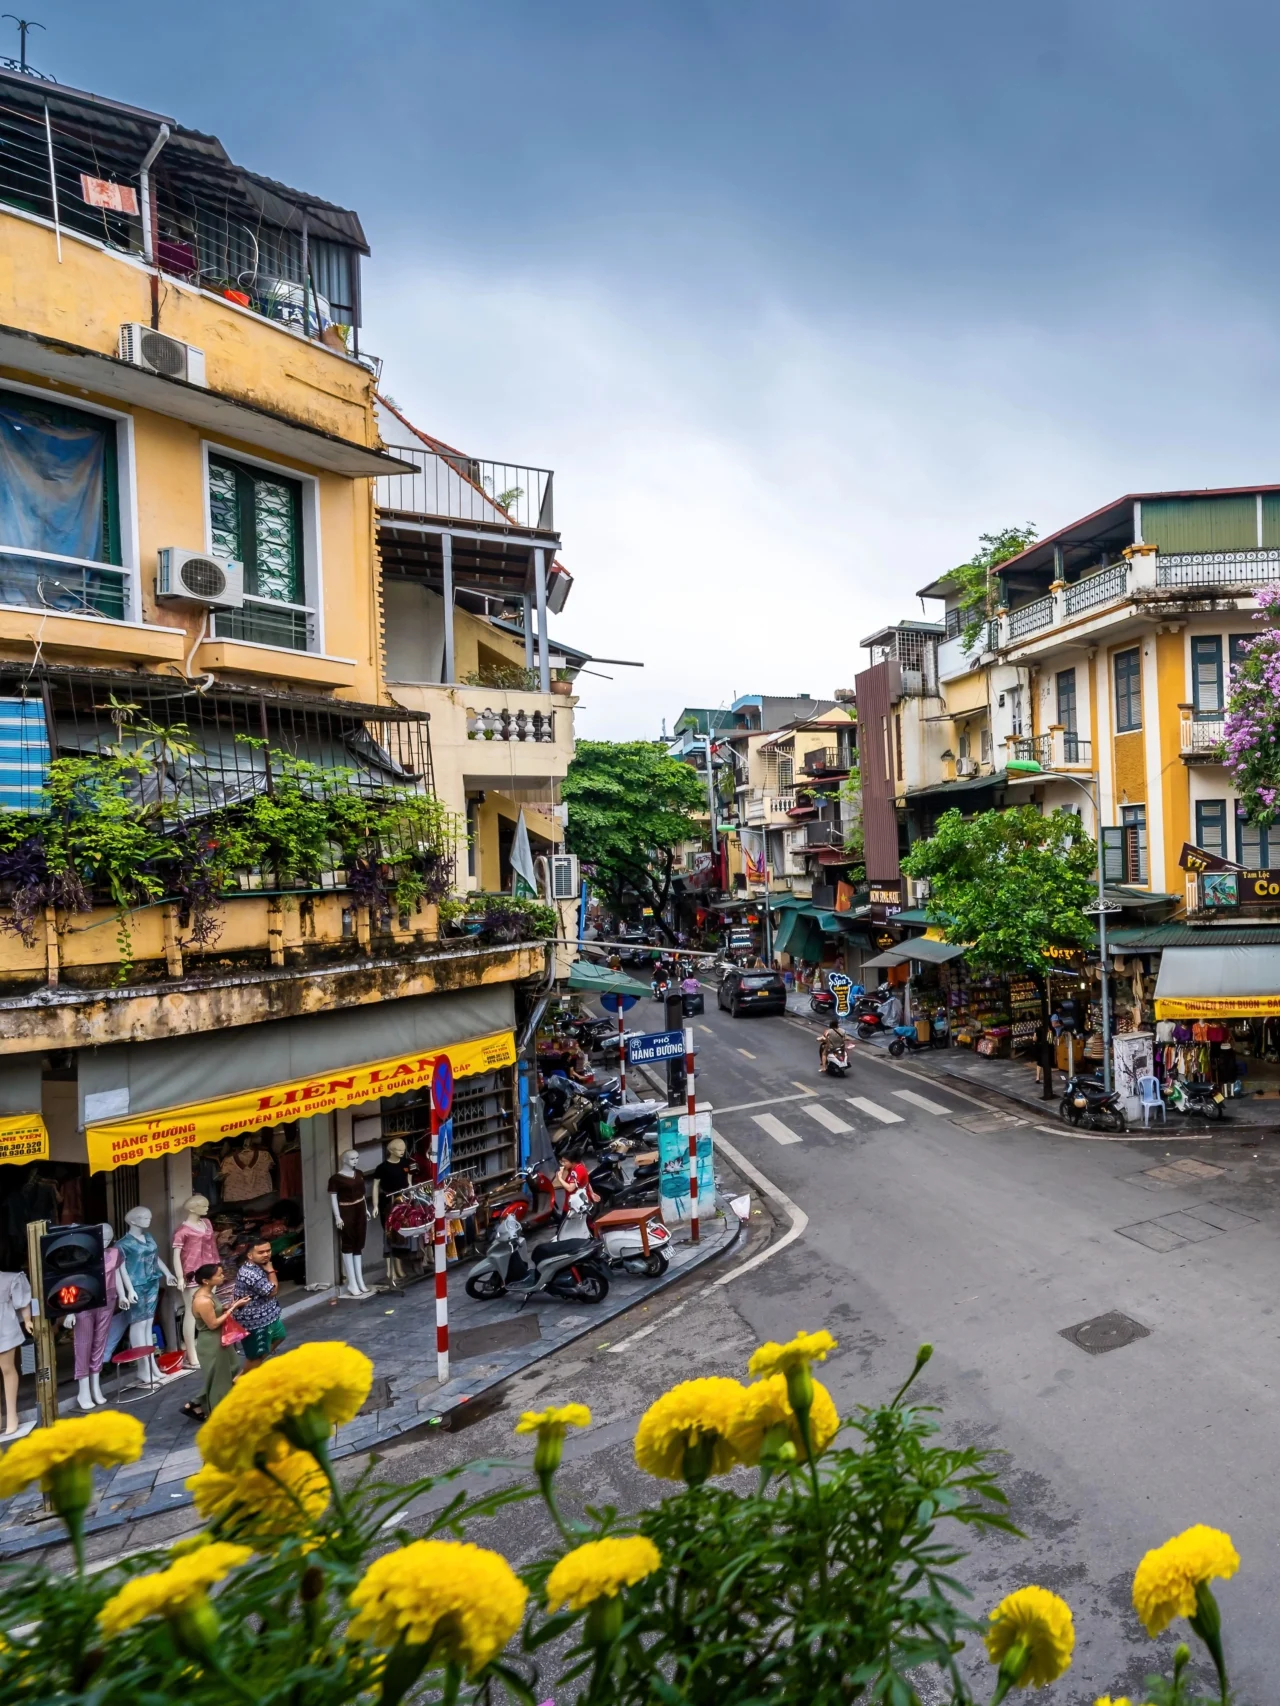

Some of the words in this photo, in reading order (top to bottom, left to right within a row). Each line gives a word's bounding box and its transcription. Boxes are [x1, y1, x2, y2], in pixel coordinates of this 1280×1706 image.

[1243, 871, 1257, 879] Tam
[632, 1047, 655, 1060] HÀNG
[656, 1042, 683, 1057] ĐƯỜNG
[653, 1035, 670, 1045] PHỐ
[256, 1075, 357, 1112] LIÊN
[368, 1053, 442, 1084] LAN
[220, 1113, 272, 1132] CHUYÊN
[276, 1105, 301, 1119] BÁN
[304, 1097, 336, 1112] BUÔN
[346, 1088, 369, 1101] BÁN
[372, 1083, 384, 1095] LẺ
[387, 1076, 414, 1091] QUẦN
[421, 1073, 430, 1084] ÁO
[112, 1133, 149, 1151] HÀNG
[152, 1122, 196, 1142] ĐƯỜNG
[146, 1119, 162, 1131] 77
[112, 1147, 144, 1164] 0989
[147, 1140, 170, 1155] 158
[173, 1133, 196, 1148] 338
